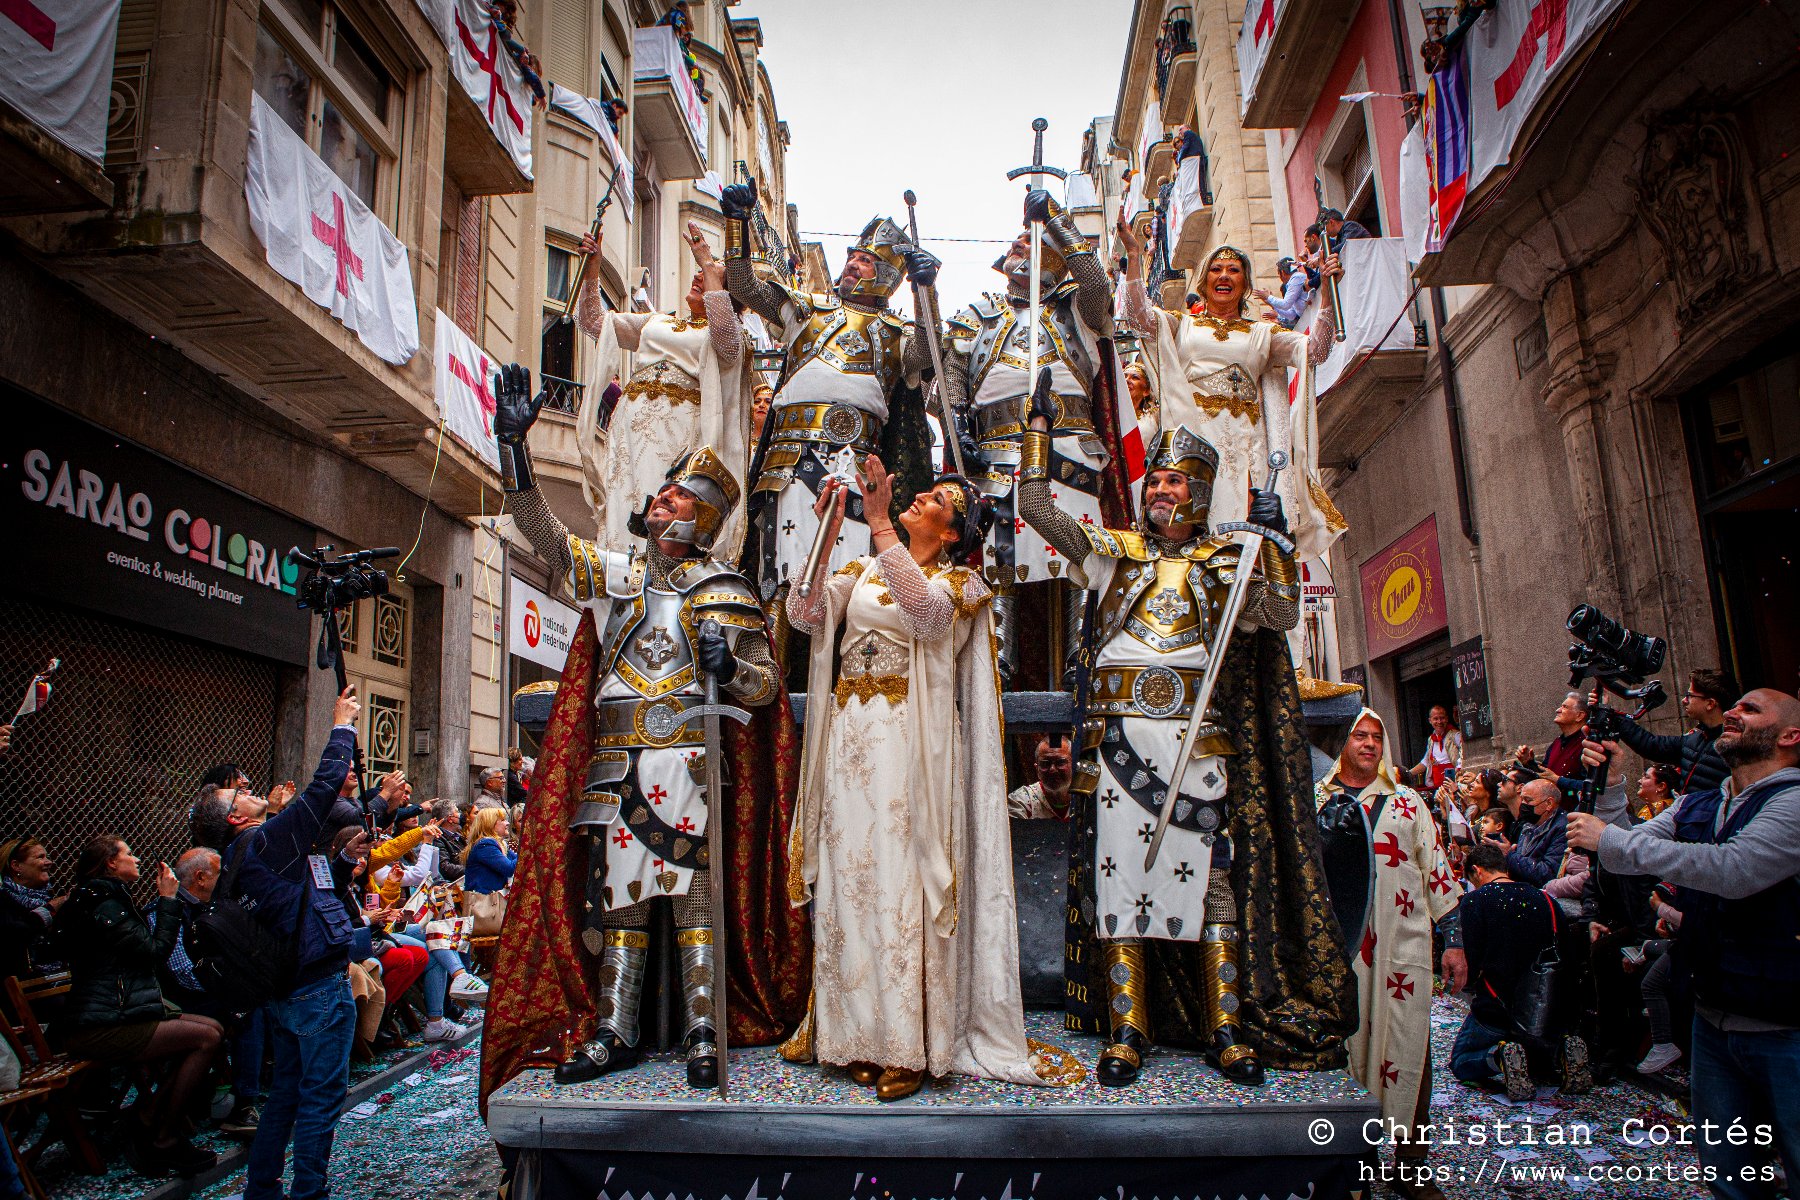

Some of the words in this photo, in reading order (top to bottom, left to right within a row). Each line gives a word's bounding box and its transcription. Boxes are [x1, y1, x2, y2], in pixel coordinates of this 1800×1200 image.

[21, 448, 153, 542] SARAO
[164, 508, 300, 596] COLORAO
[106, 551, 151, 575] eventos
[152, 561, 162, 579] &
[164, 569, 207, 597] wedding
[208, 581, 244, 605] planner
[542, 616, 568, 637] nationale
